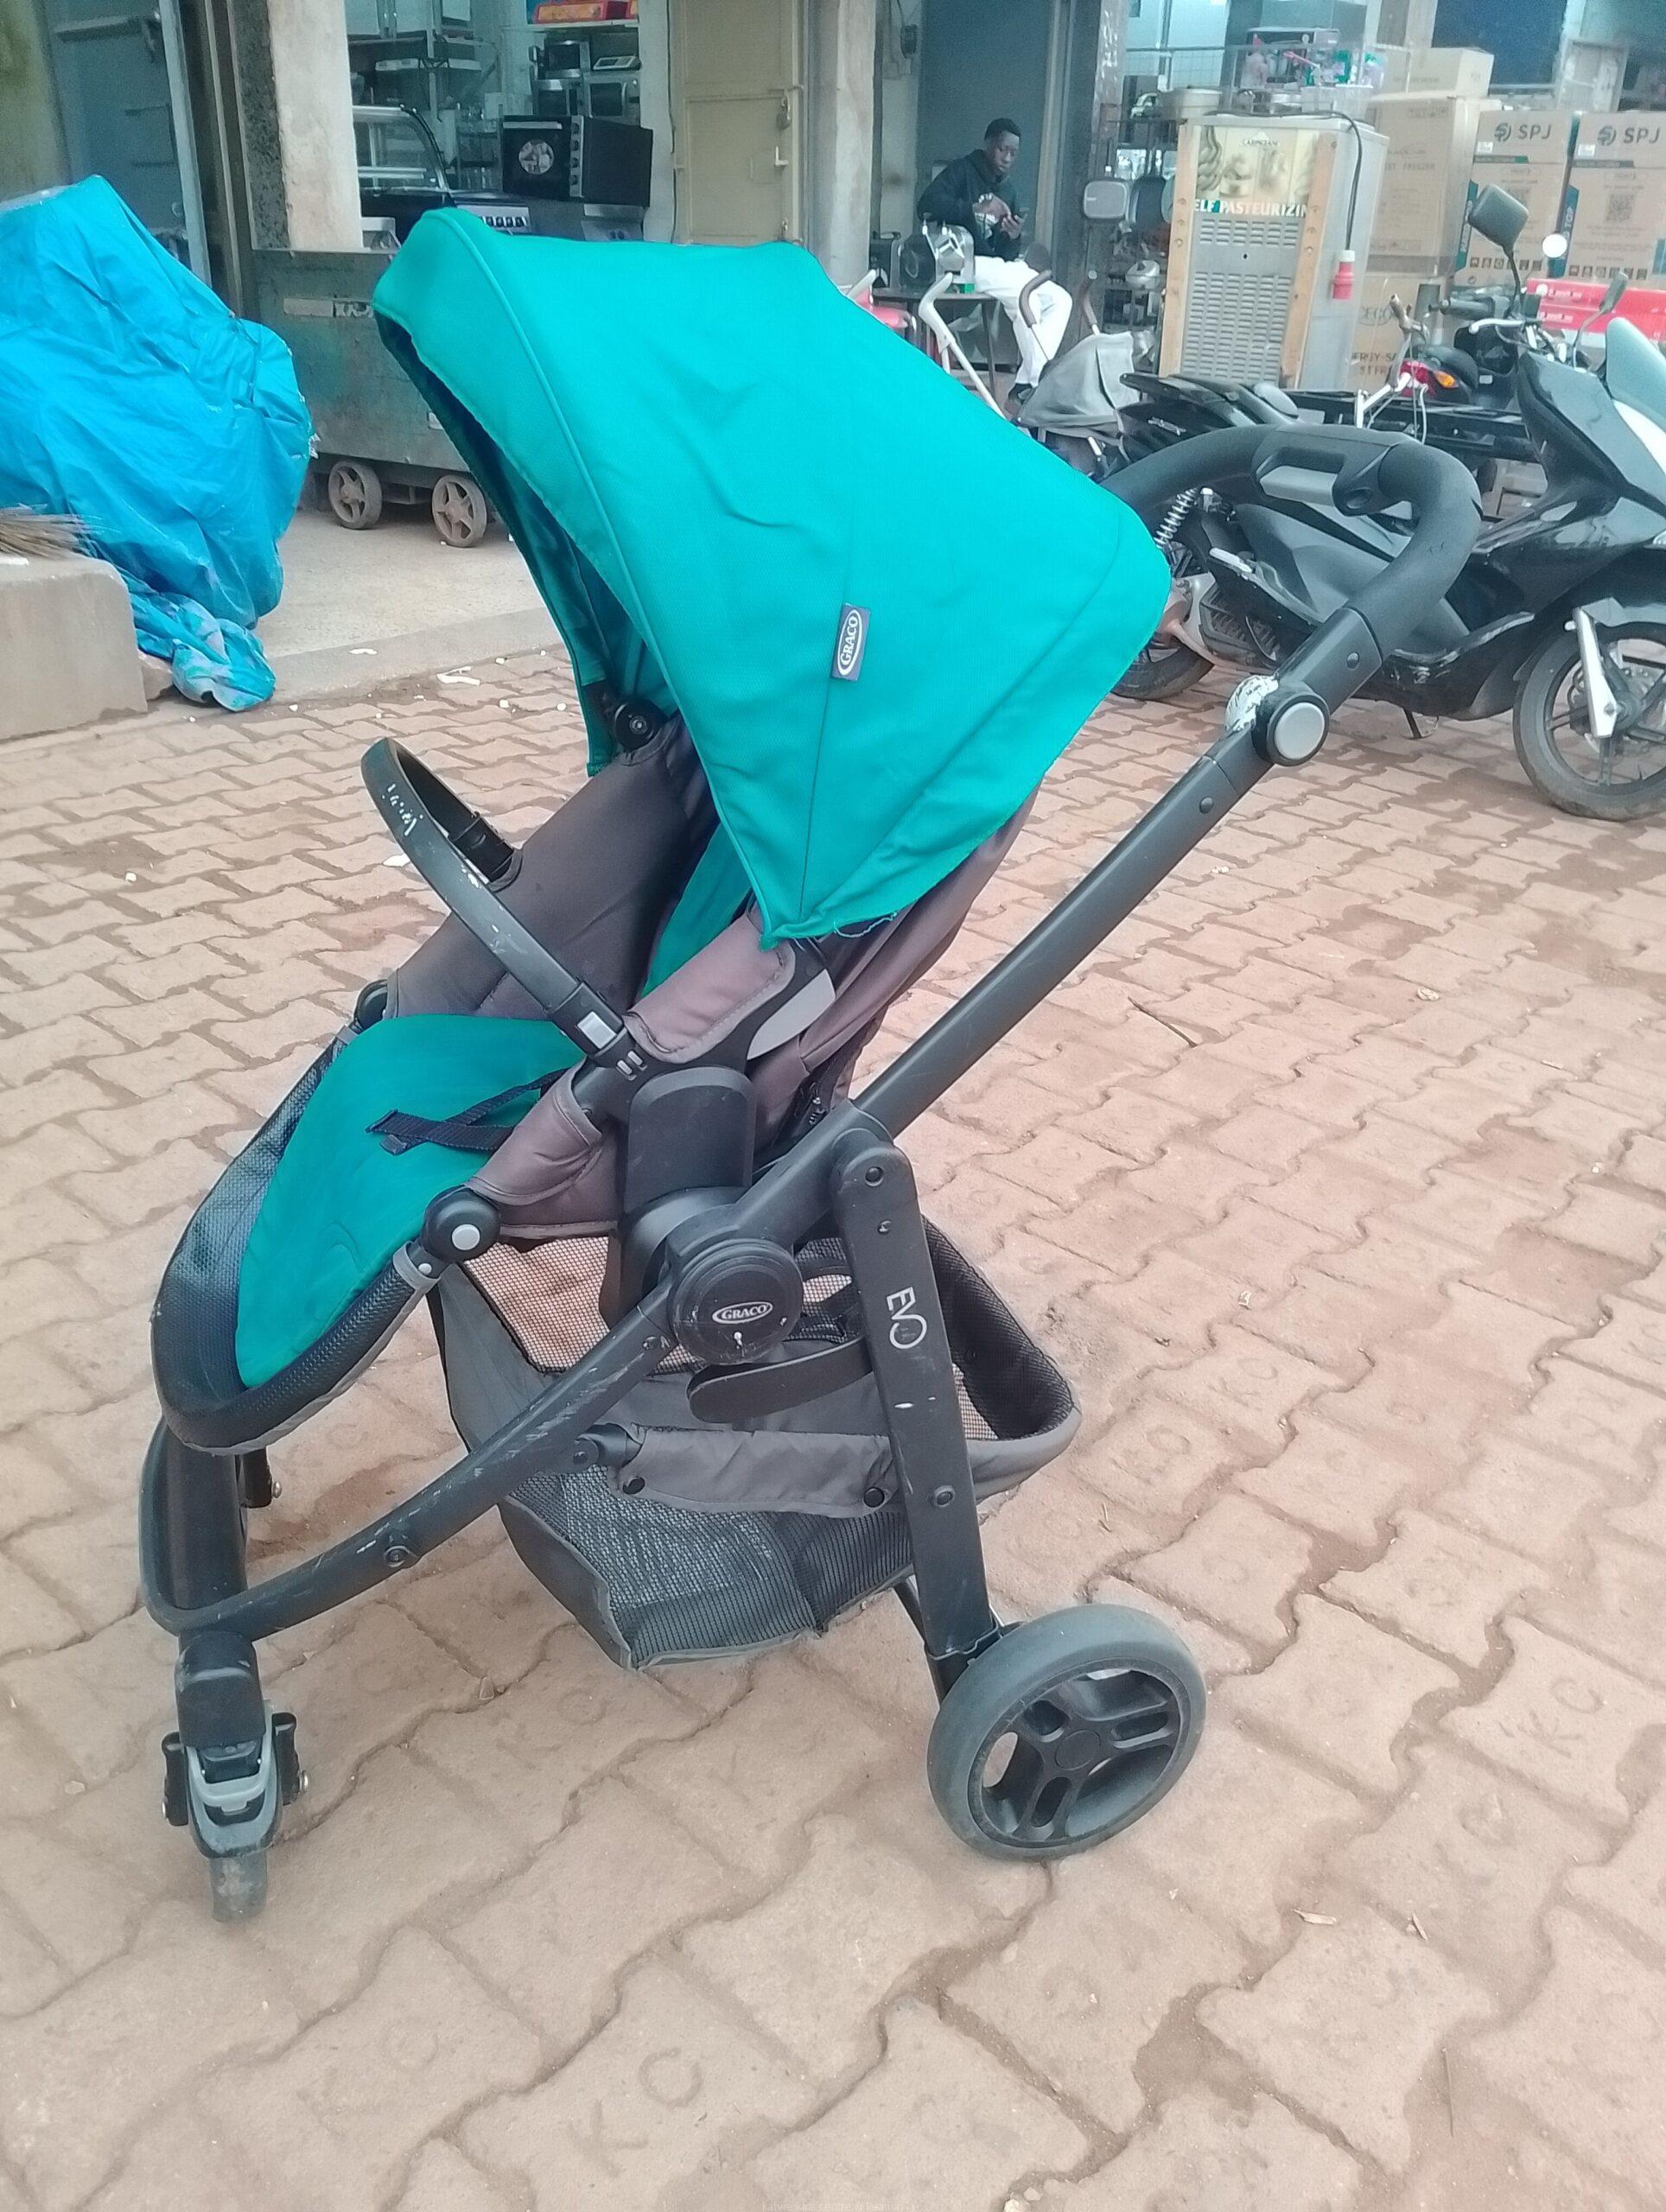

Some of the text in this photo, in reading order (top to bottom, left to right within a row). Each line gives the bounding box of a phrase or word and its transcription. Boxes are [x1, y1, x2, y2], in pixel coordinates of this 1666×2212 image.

[1518, 124, 1552, 140] SPJ
[1623, 126, 1661, 144] SPJ
[840, 615, 859, 666] GRACO
[720, 1303, 769, 1322] GRACO
[886, 1286, 928, 1350] EVO
